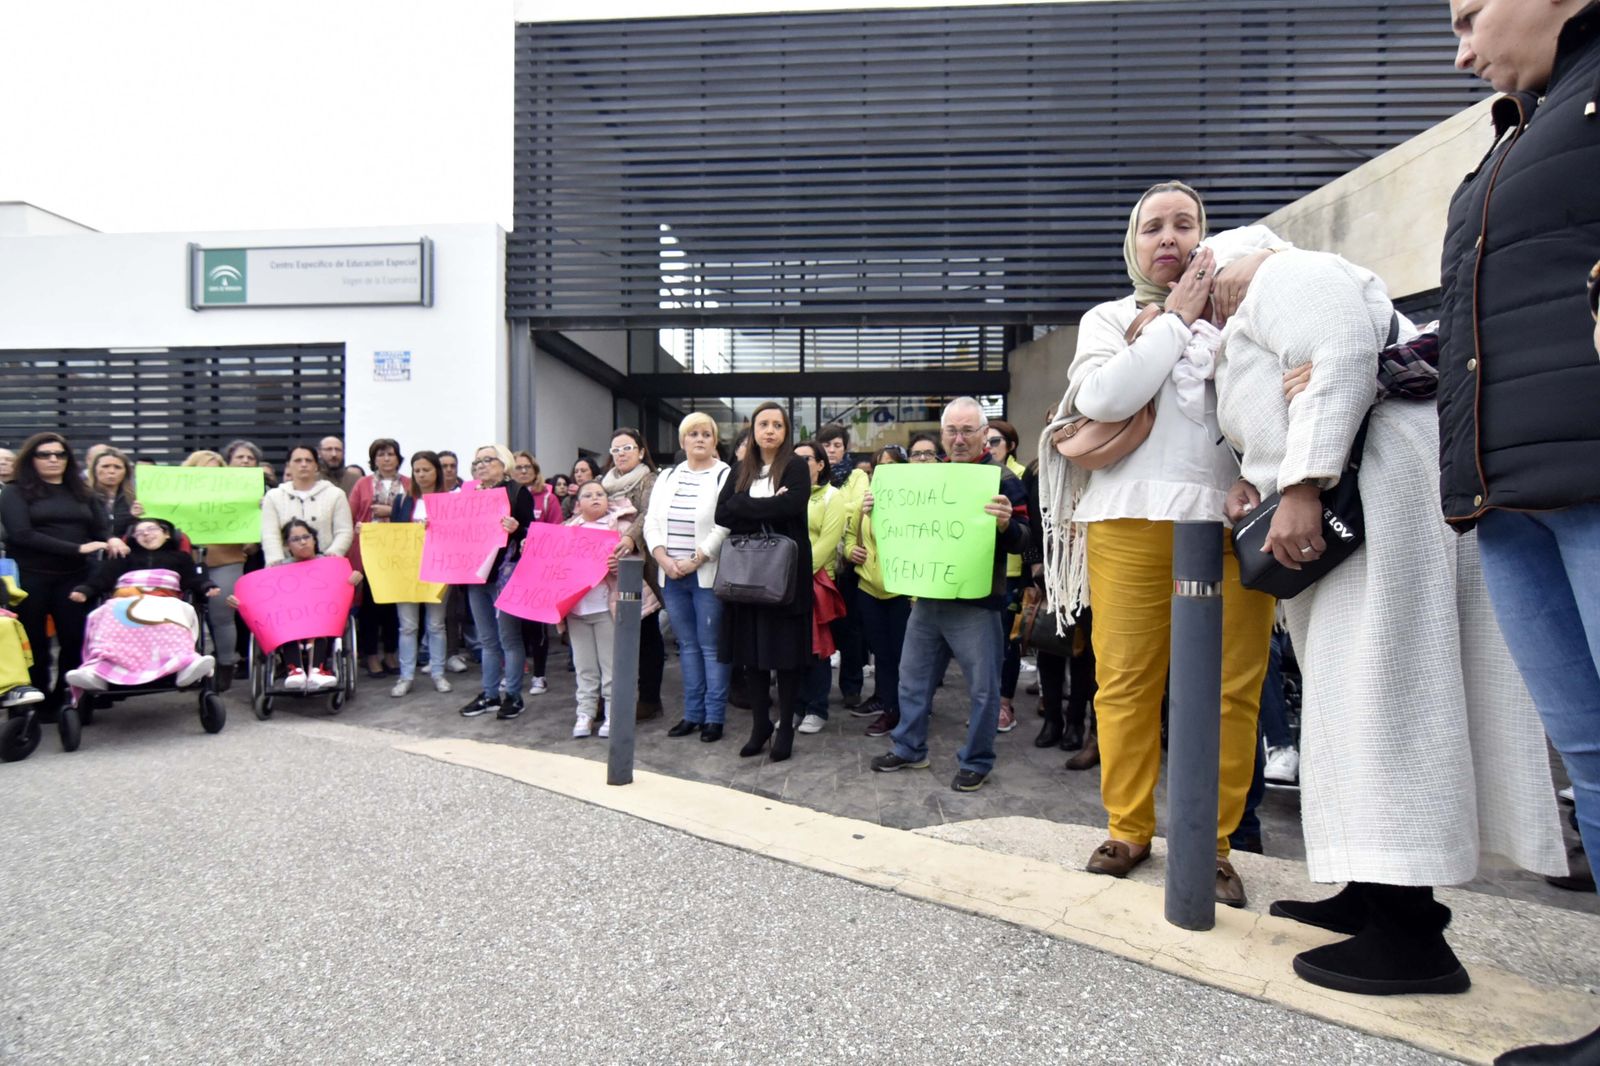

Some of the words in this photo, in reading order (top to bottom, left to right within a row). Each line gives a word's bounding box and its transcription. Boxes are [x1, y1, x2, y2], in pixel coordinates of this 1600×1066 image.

[335, 259, 344, 268] de
[387, 257, 418, 268] Especial
[875, 478, 958, 512] PERSONAL
[881, 518, 966, 541] SANITARIO
